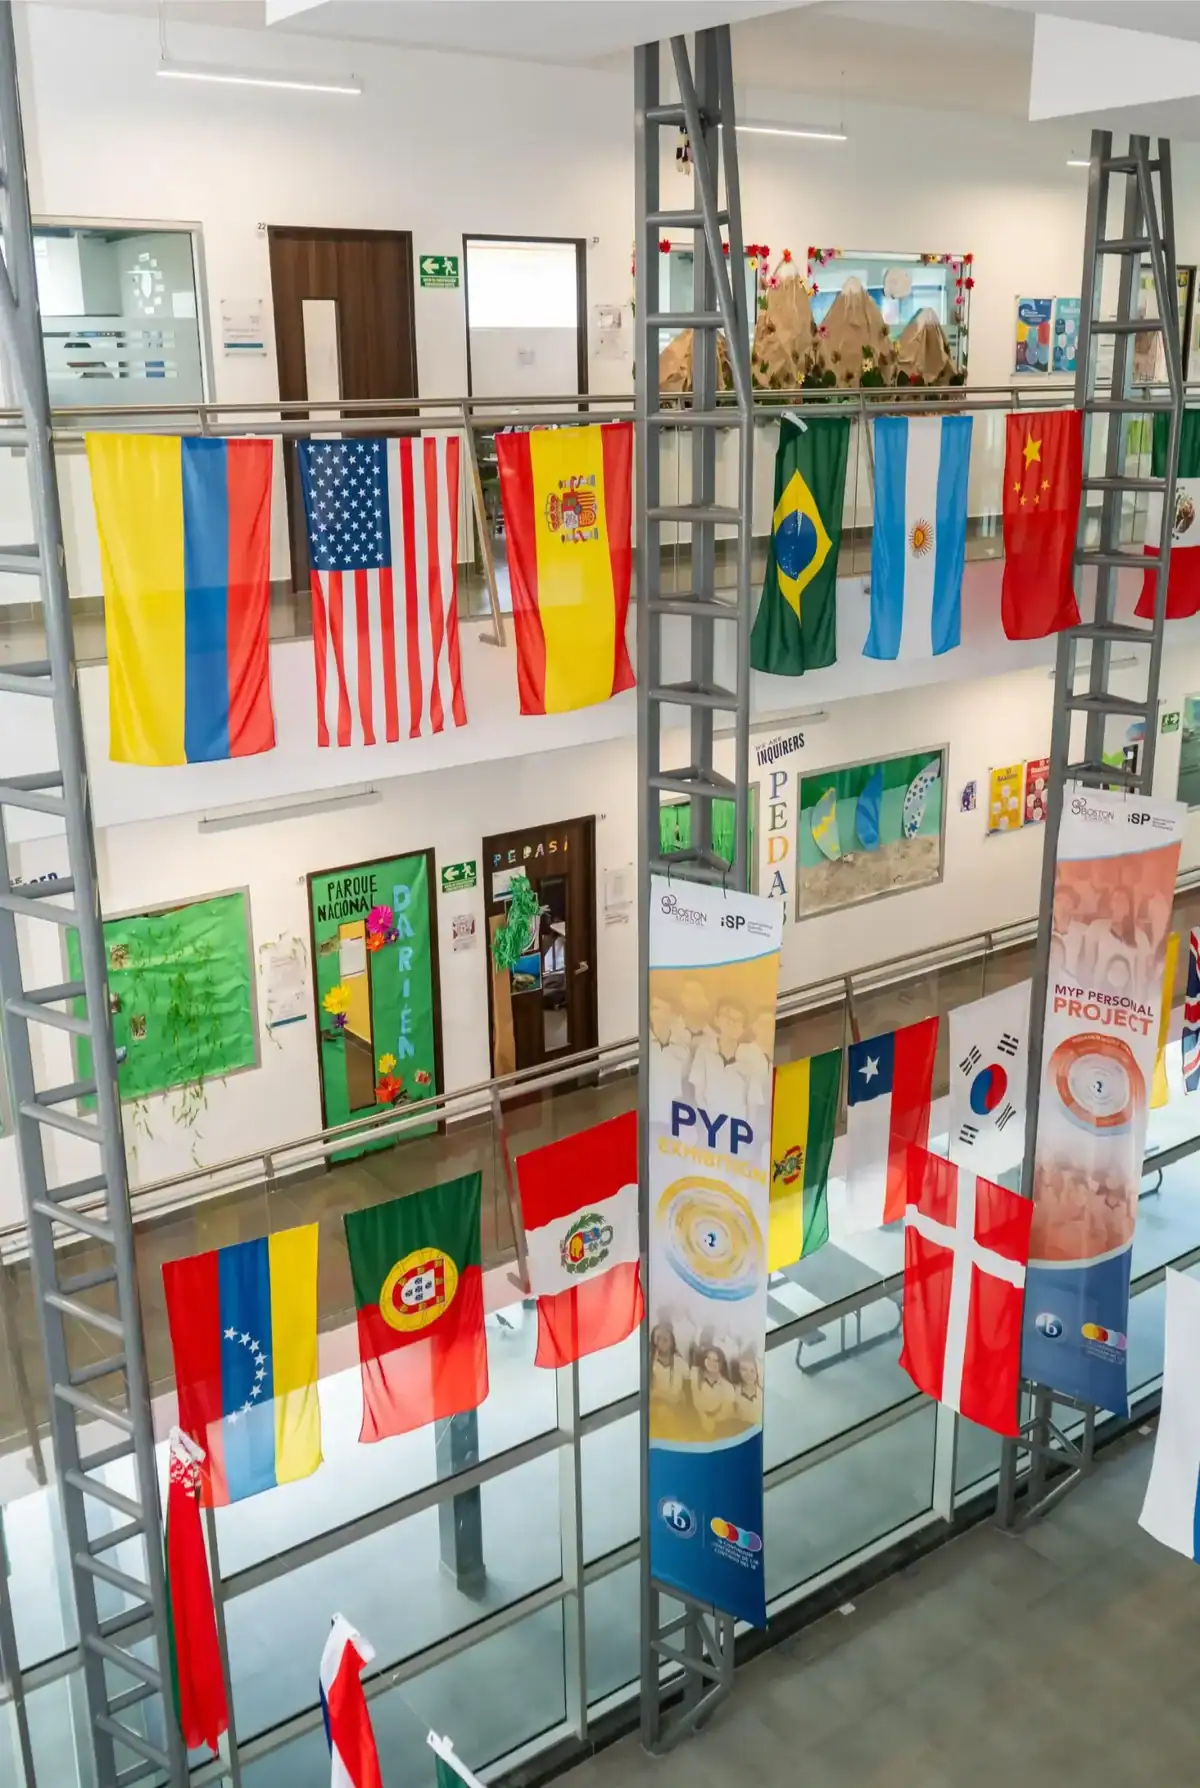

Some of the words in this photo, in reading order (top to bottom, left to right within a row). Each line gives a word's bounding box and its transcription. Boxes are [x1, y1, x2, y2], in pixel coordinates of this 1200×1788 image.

[757, 732, 805, 766] INQUIRERS
[1080, 807, 1115, 820] BOSTON
[767, 770, 789, 926] PEDA
[327, 874, 378, 902] PARQUE
[318, 893, 377, 923] NACIONAL
[672, 906, 707, 922] BOSTON
[1053, 996, 1154, 1036] PROJECT
[1055, 984, 1084, 998] MYP
[1088, 990, 1154, 1017] PERSONAL
[671, 1100, 754, 1155] PYP
